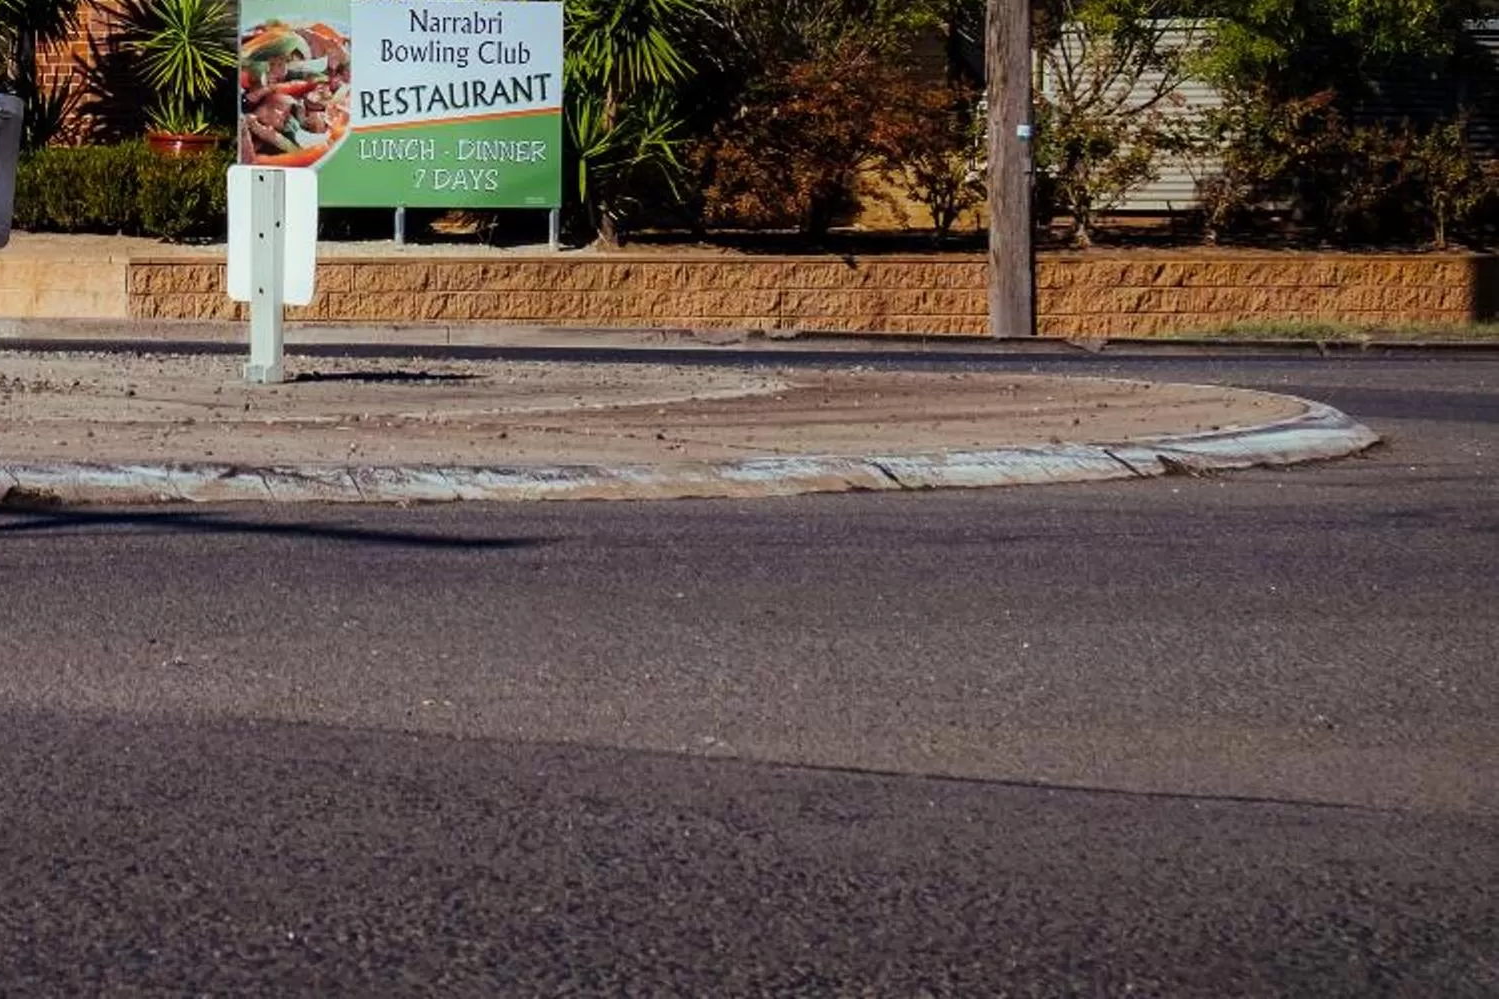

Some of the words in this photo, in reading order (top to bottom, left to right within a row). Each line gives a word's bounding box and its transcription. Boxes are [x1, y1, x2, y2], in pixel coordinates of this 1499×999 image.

[409, 9, 503, 35] Narrabri
[381, 39, 469, 68] Bowling
[478, 41, 531, 65] Club
[360, 73, 553, 119] RESTAURANT
[359, 138, 435, 161] LUNCH
[457, 139, 547, 162] DINNER
[412, 169, 427, 189] 7
[433, 168, 500, 191] DAYS
